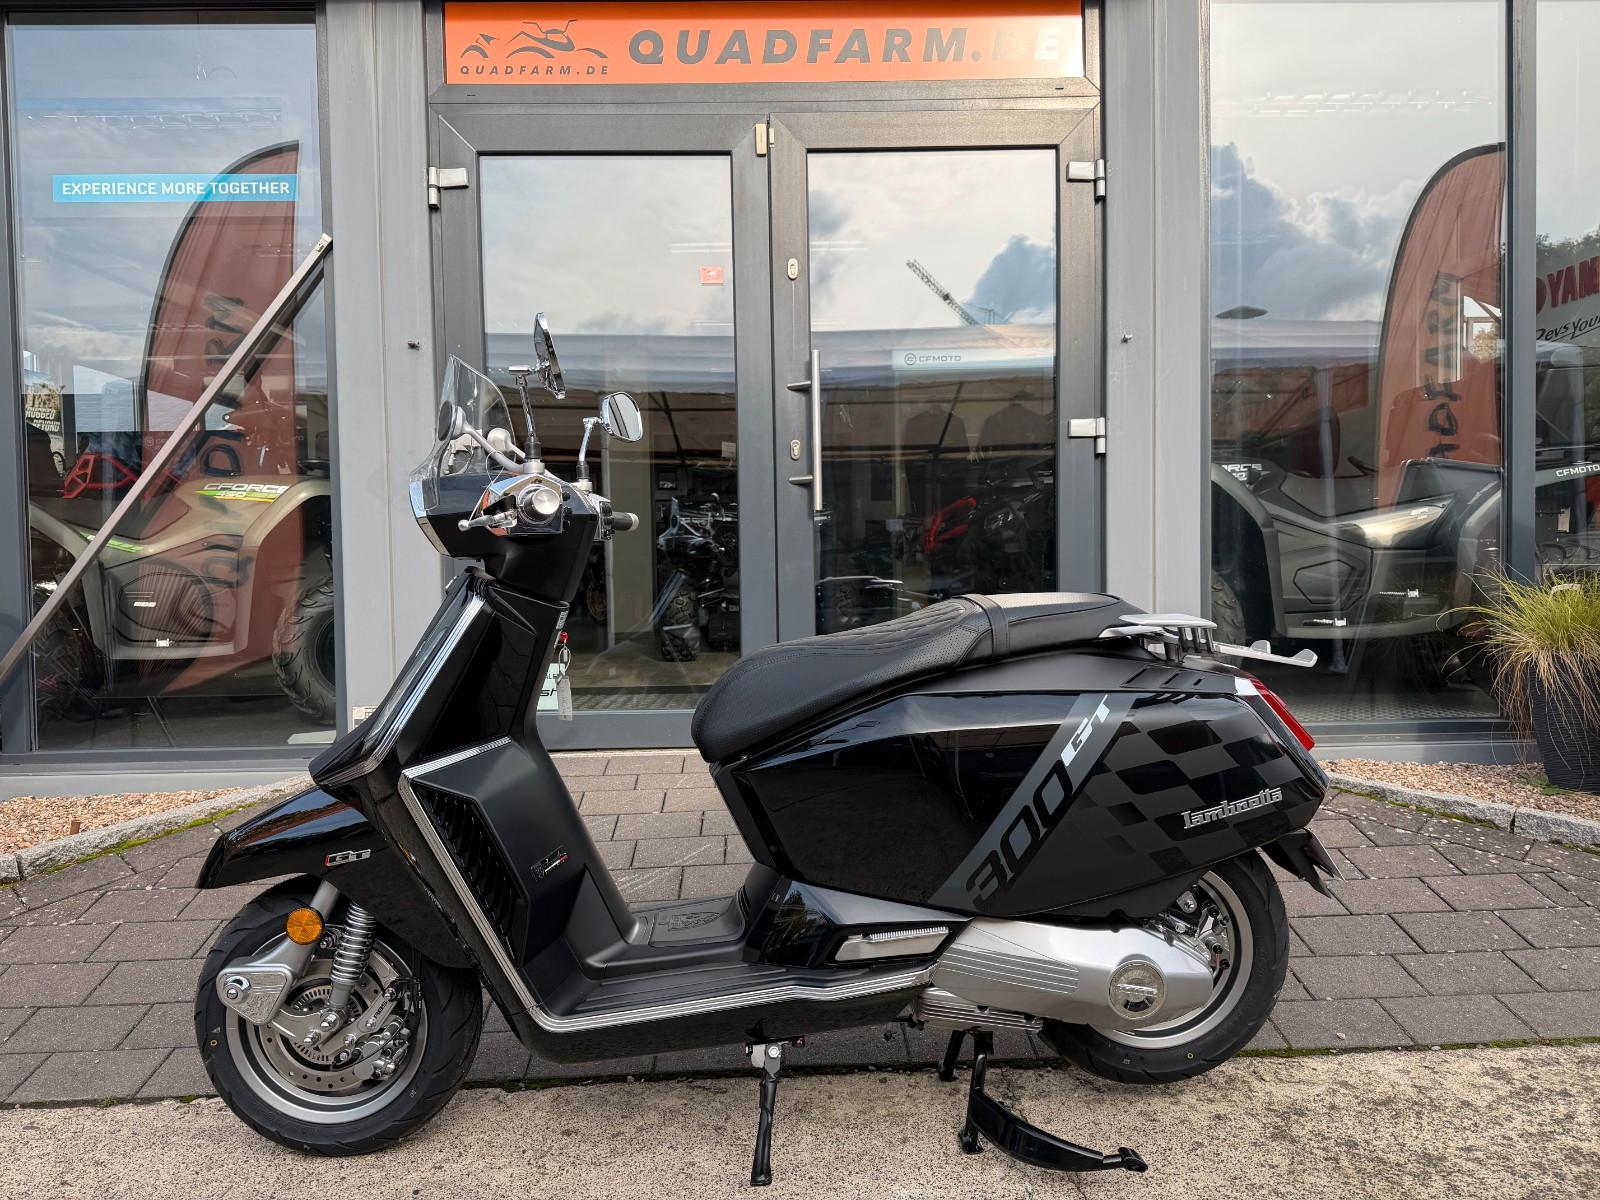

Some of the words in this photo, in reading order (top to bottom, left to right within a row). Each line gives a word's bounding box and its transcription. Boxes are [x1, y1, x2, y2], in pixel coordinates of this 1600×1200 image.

[629, 28, 1062, 65] QUADFARM.DE
[460, 66, 608, 75] QUADFARM.DE
[62, 182, 157, 195] EXPERIENCE
[161, 182, 205, 194] MORE
[210, 181, 290, 194] TOGETHER
[918, 355, 962, 363] CFMOTO
[1556, 464, 1600, 477] CFMOTO
[203, 483, 290, 494] CFORCE
[966, 759, 1074, 911] 300
[1060, 694, 1111, 767] GT
[324, 849, 371, 867] GT
